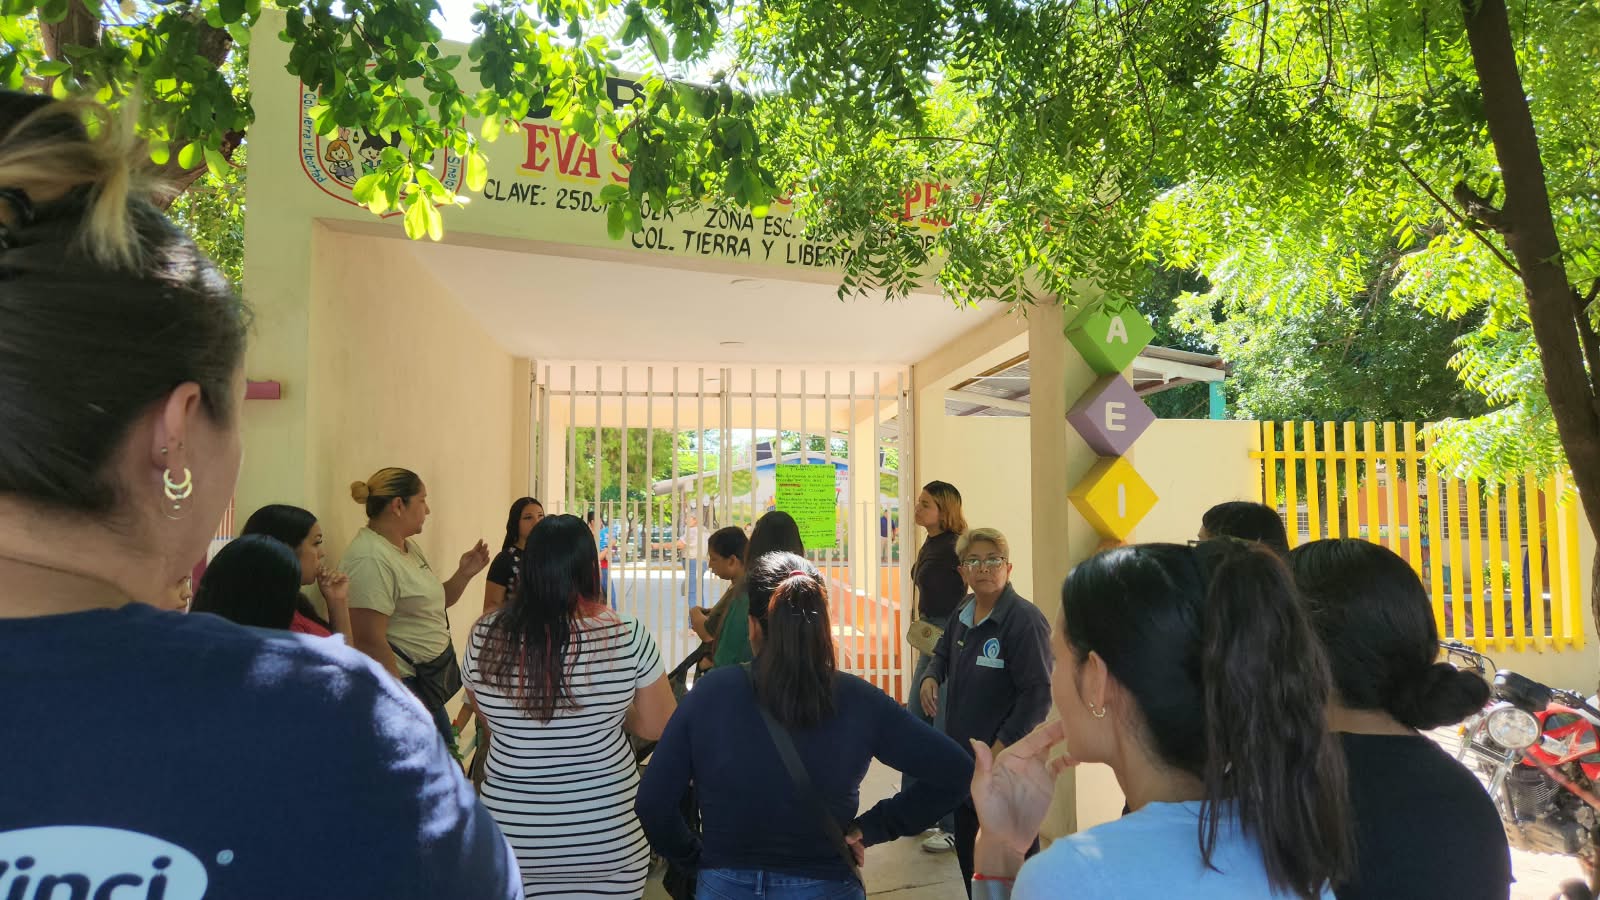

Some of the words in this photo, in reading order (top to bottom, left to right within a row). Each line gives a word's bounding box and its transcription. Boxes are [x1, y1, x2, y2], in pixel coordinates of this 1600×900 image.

[483, 178, 547, 206] CLAVE:
[704, 205, 754, 232] ZONA
[763, 215, 797, 239] ESC.
[631, 226, 675, 251] COL.
[682, 229, 751, 259] TIERRA
[761, 238, 775, 261] Y
[1106, 315, 1128, 344] A
[1105, 402, 1126, 431] E
[1117, 483, 1126, 518] I
[0, 855, 172, 900] inci
